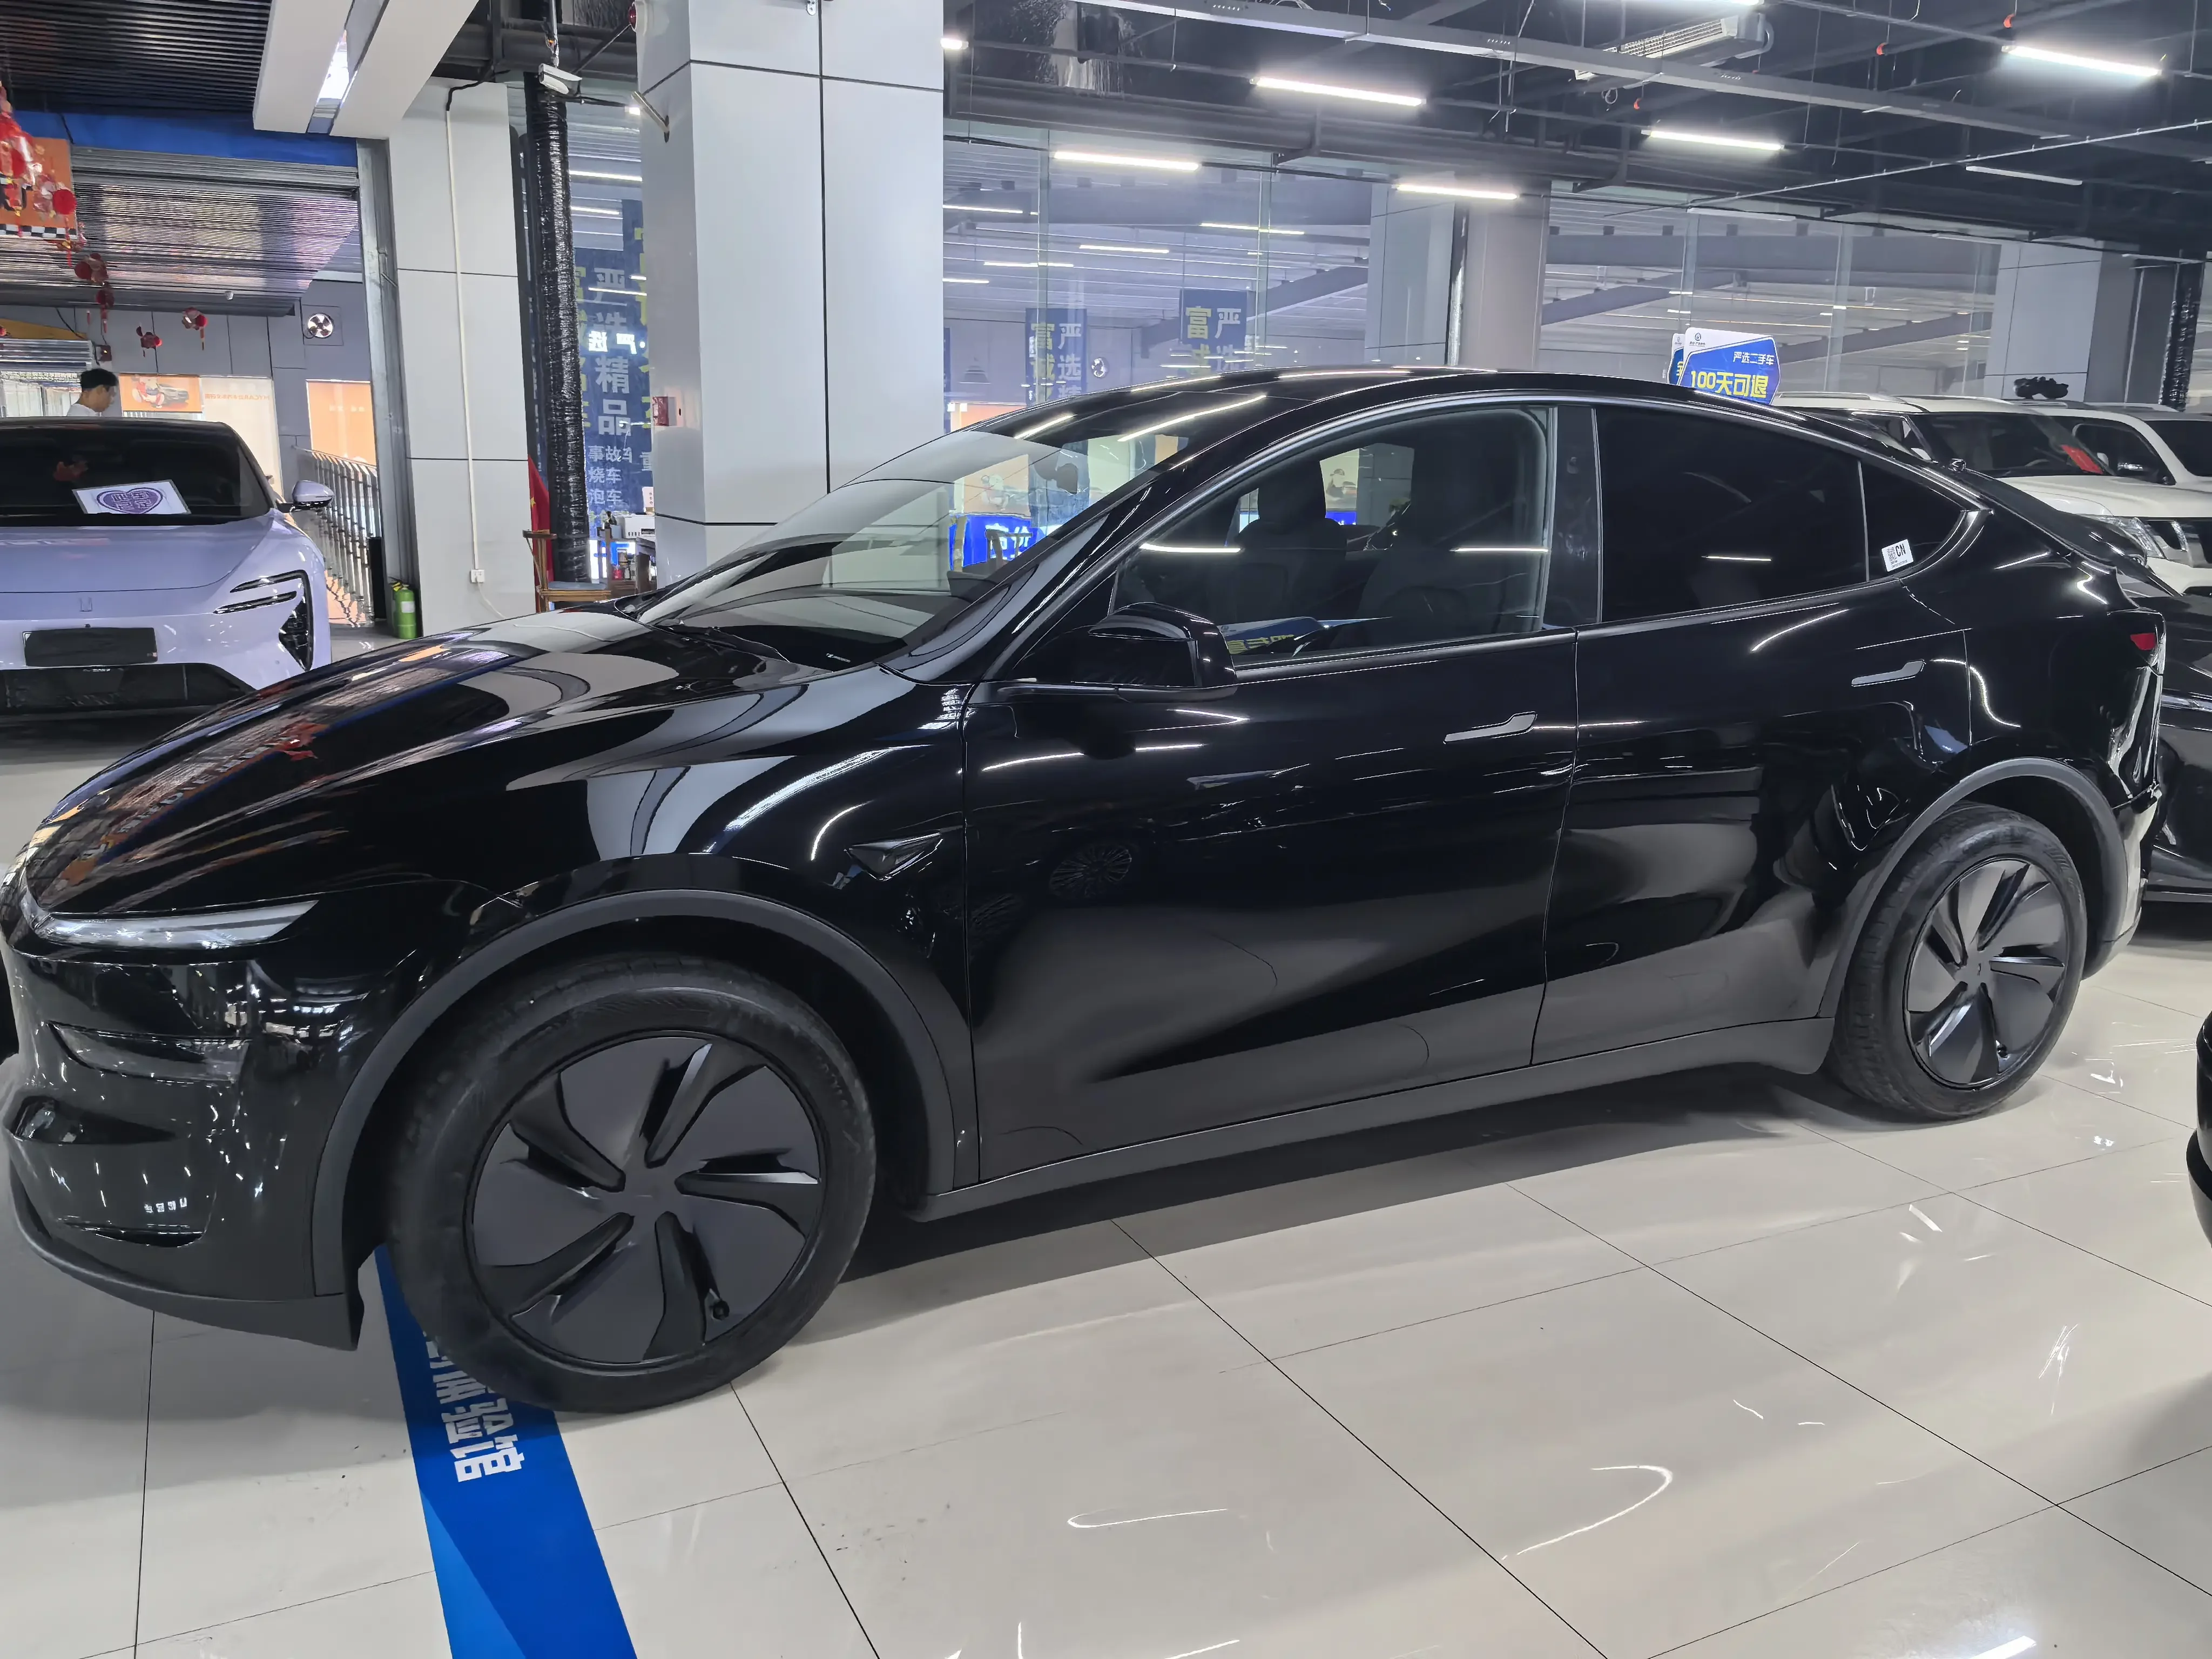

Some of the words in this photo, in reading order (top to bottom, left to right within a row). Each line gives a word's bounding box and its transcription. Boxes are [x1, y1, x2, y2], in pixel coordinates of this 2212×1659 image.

[1732, 351, 1775, 366] 严选二手车
[1691, 370, 1769, 398] 100天可退
[1895, 543, 1906, 557] CN
[426, 1341, 525, 1482] 体验馆
